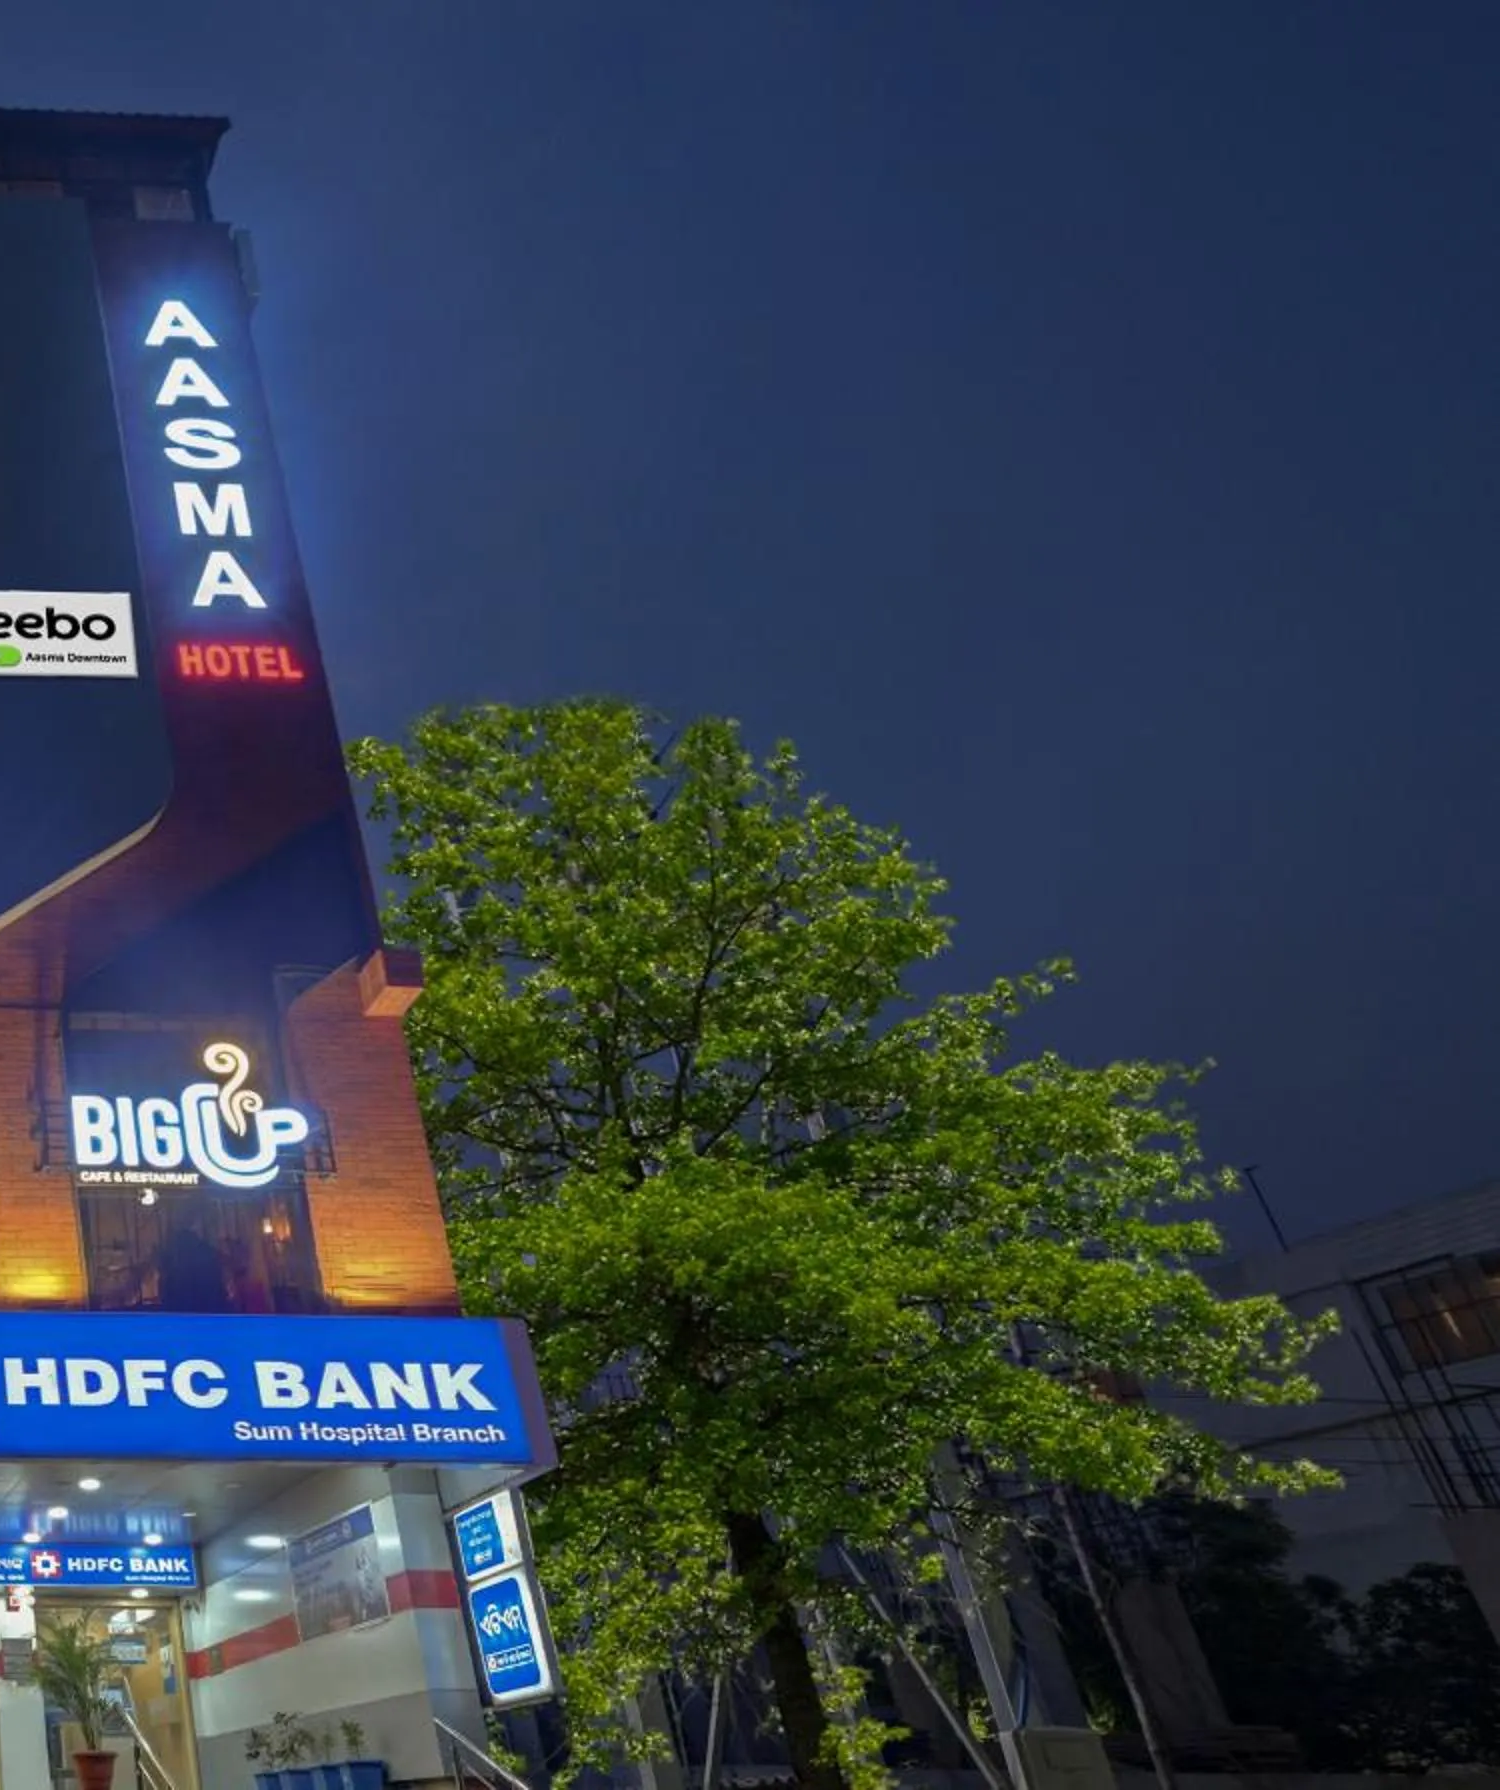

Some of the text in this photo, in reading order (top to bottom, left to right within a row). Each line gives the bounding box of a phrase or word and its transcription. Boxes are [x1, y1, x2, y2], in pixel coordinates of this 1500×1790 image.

[145, 300, 268, 608] AASMA
[25, 651, 128, 664] Aasma Downtown
[177, 643, 304, 680] HOTEL
[3, 1357, 498, 1412] HDFC BANK
[234, 1420, 506, 1446] Sum Hospital Branch
[67, 1557, 190, 1573] HDFC BANK
